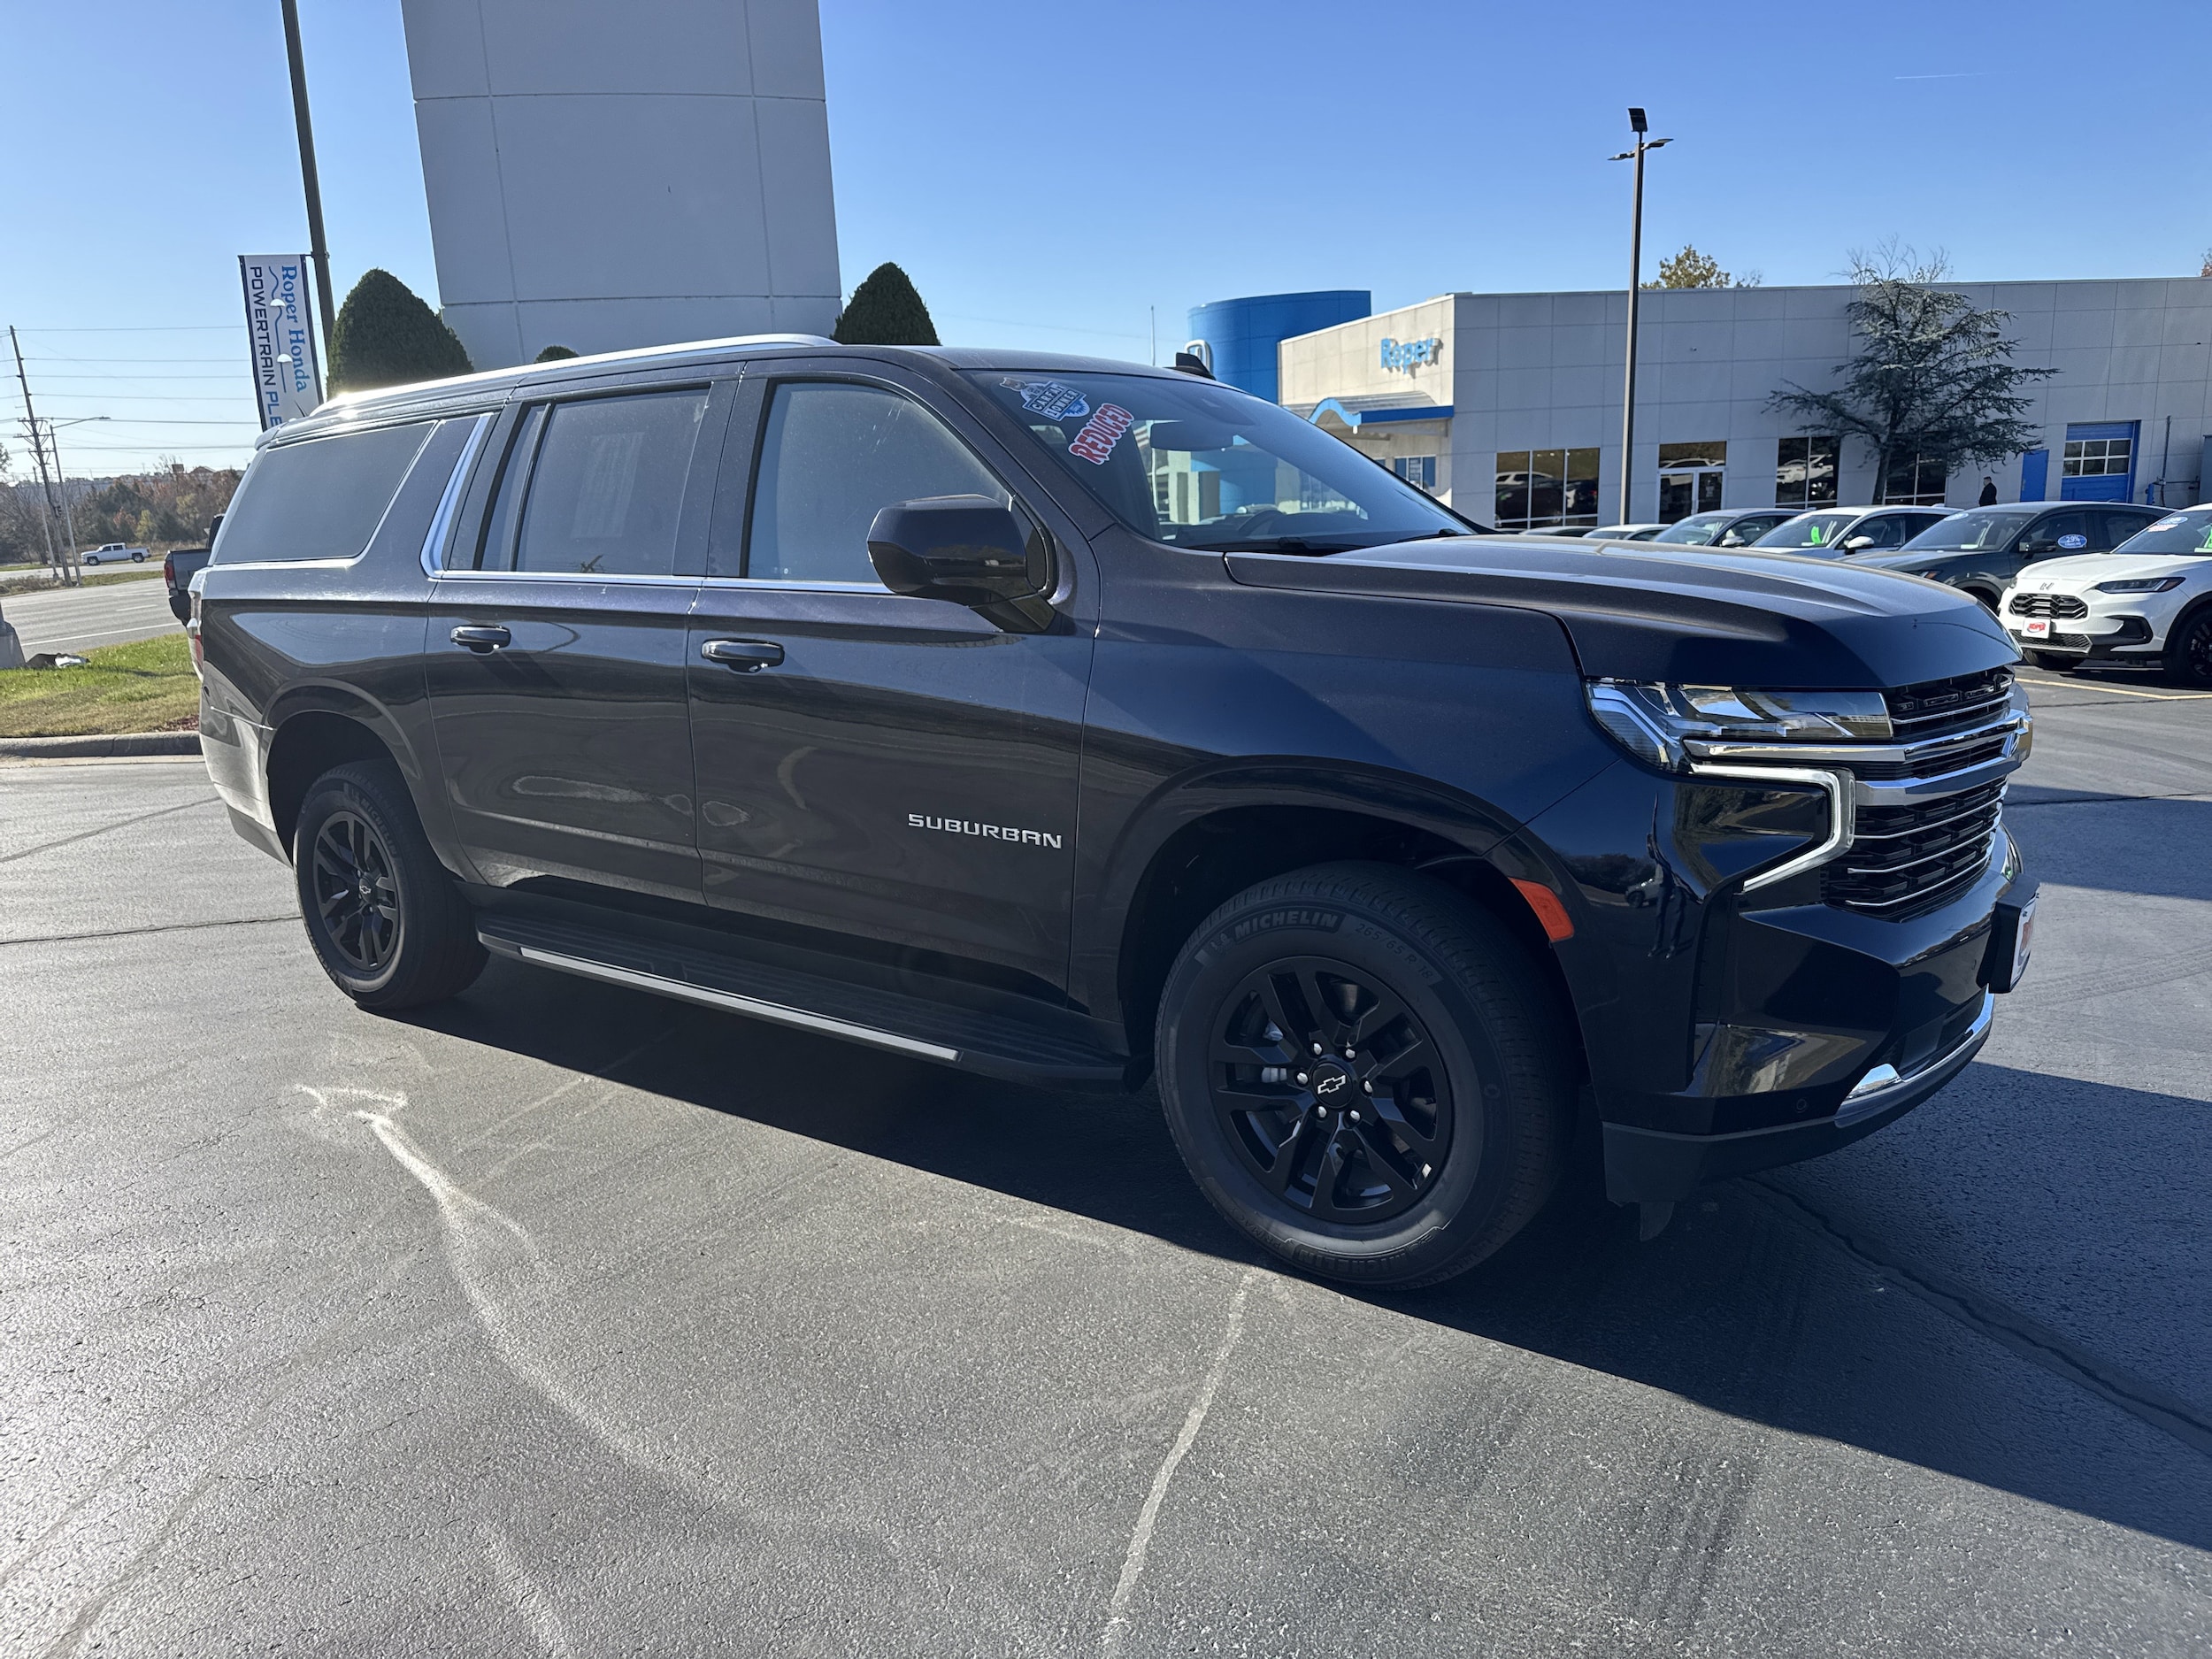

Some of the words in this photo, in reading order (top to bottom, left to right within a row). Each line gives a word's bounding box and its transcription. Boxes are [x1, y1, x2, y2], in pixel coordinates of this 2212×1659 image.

[281, 265, 298, 323] Roper
[250, 266, 276, 386] POWERTRAIN
[288, 329, 310, 393] Honda
[1381, 338, 1433, 374] Roper
[1070, 403, 1133, 465] REDUCED
[908, 813, 1062, 849] SUBURBAN
[1234, 910, 1339, 939] MICHELIN
[1355, 923, 1405, 955] 265/65
